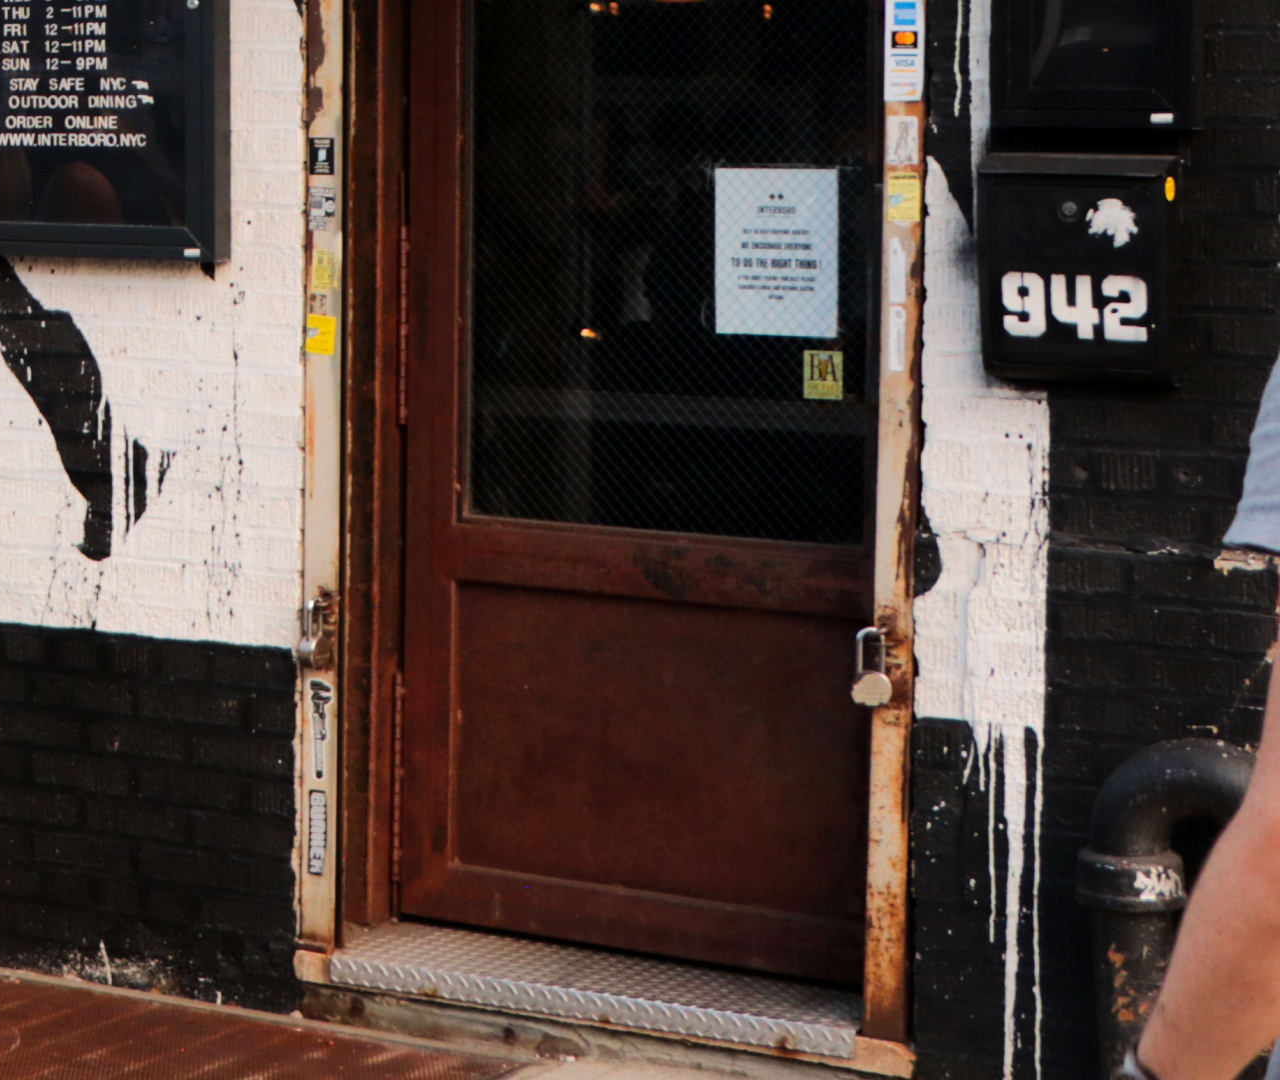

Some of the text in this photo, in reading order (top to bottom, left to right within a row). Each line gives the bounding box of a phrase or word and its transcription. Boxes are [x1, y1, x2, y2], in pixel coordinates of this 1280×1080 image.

[1, 6, 31, 20] THU
[3, 23, 28, 37] FRI
[2, 40, 30, 53] SAT
[2, 57, 30, 71] SUN
[9, 77, 127, 91] STAY SAFE NYC
[8, 94, 137, 109] OUTDOOR DINING
[5, 115, 118, 130] ORDER ONLINE
[755, 257, 768, 269] THE
[1001, 271, 1148, 342] 942
